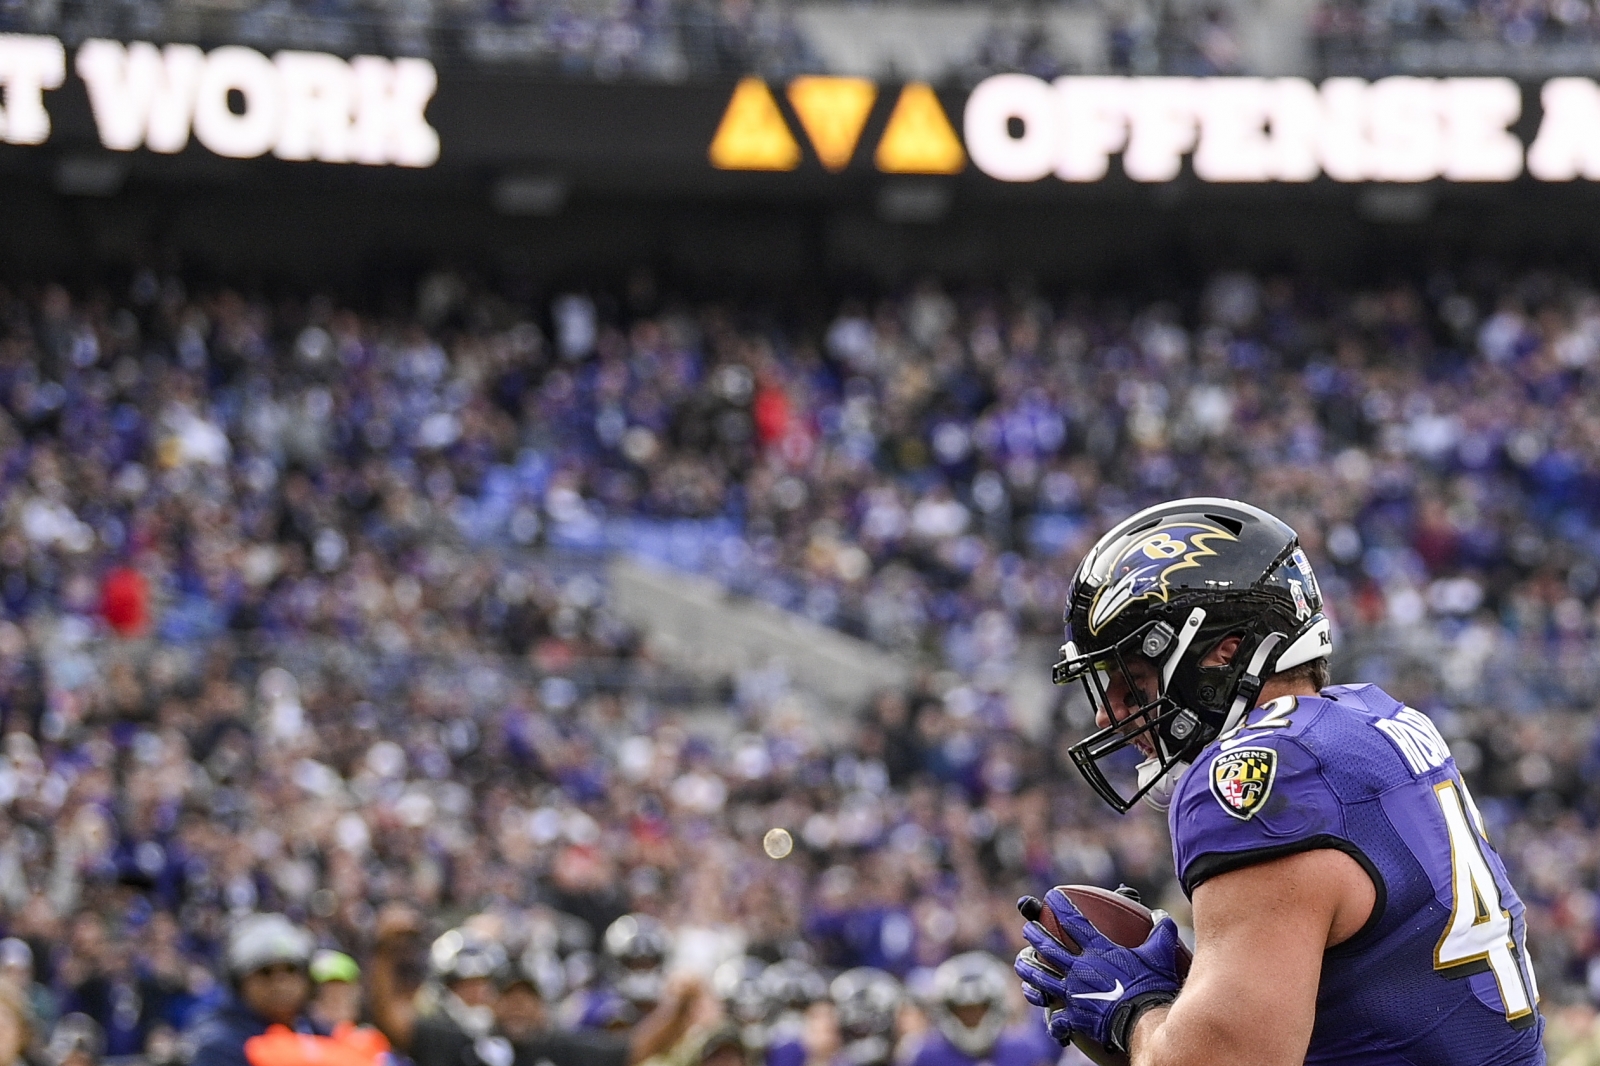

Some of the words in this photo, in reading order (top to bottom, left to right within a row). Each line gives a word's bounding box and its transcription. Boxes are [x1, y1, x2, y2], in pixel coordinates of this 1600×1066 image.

[0, 32, 66, 146] T
[76, 37, 441, 168] WORK
[963, 73, 1522, 182] OFFENSE
[1218, 751, 1268, 766] RAVENS
